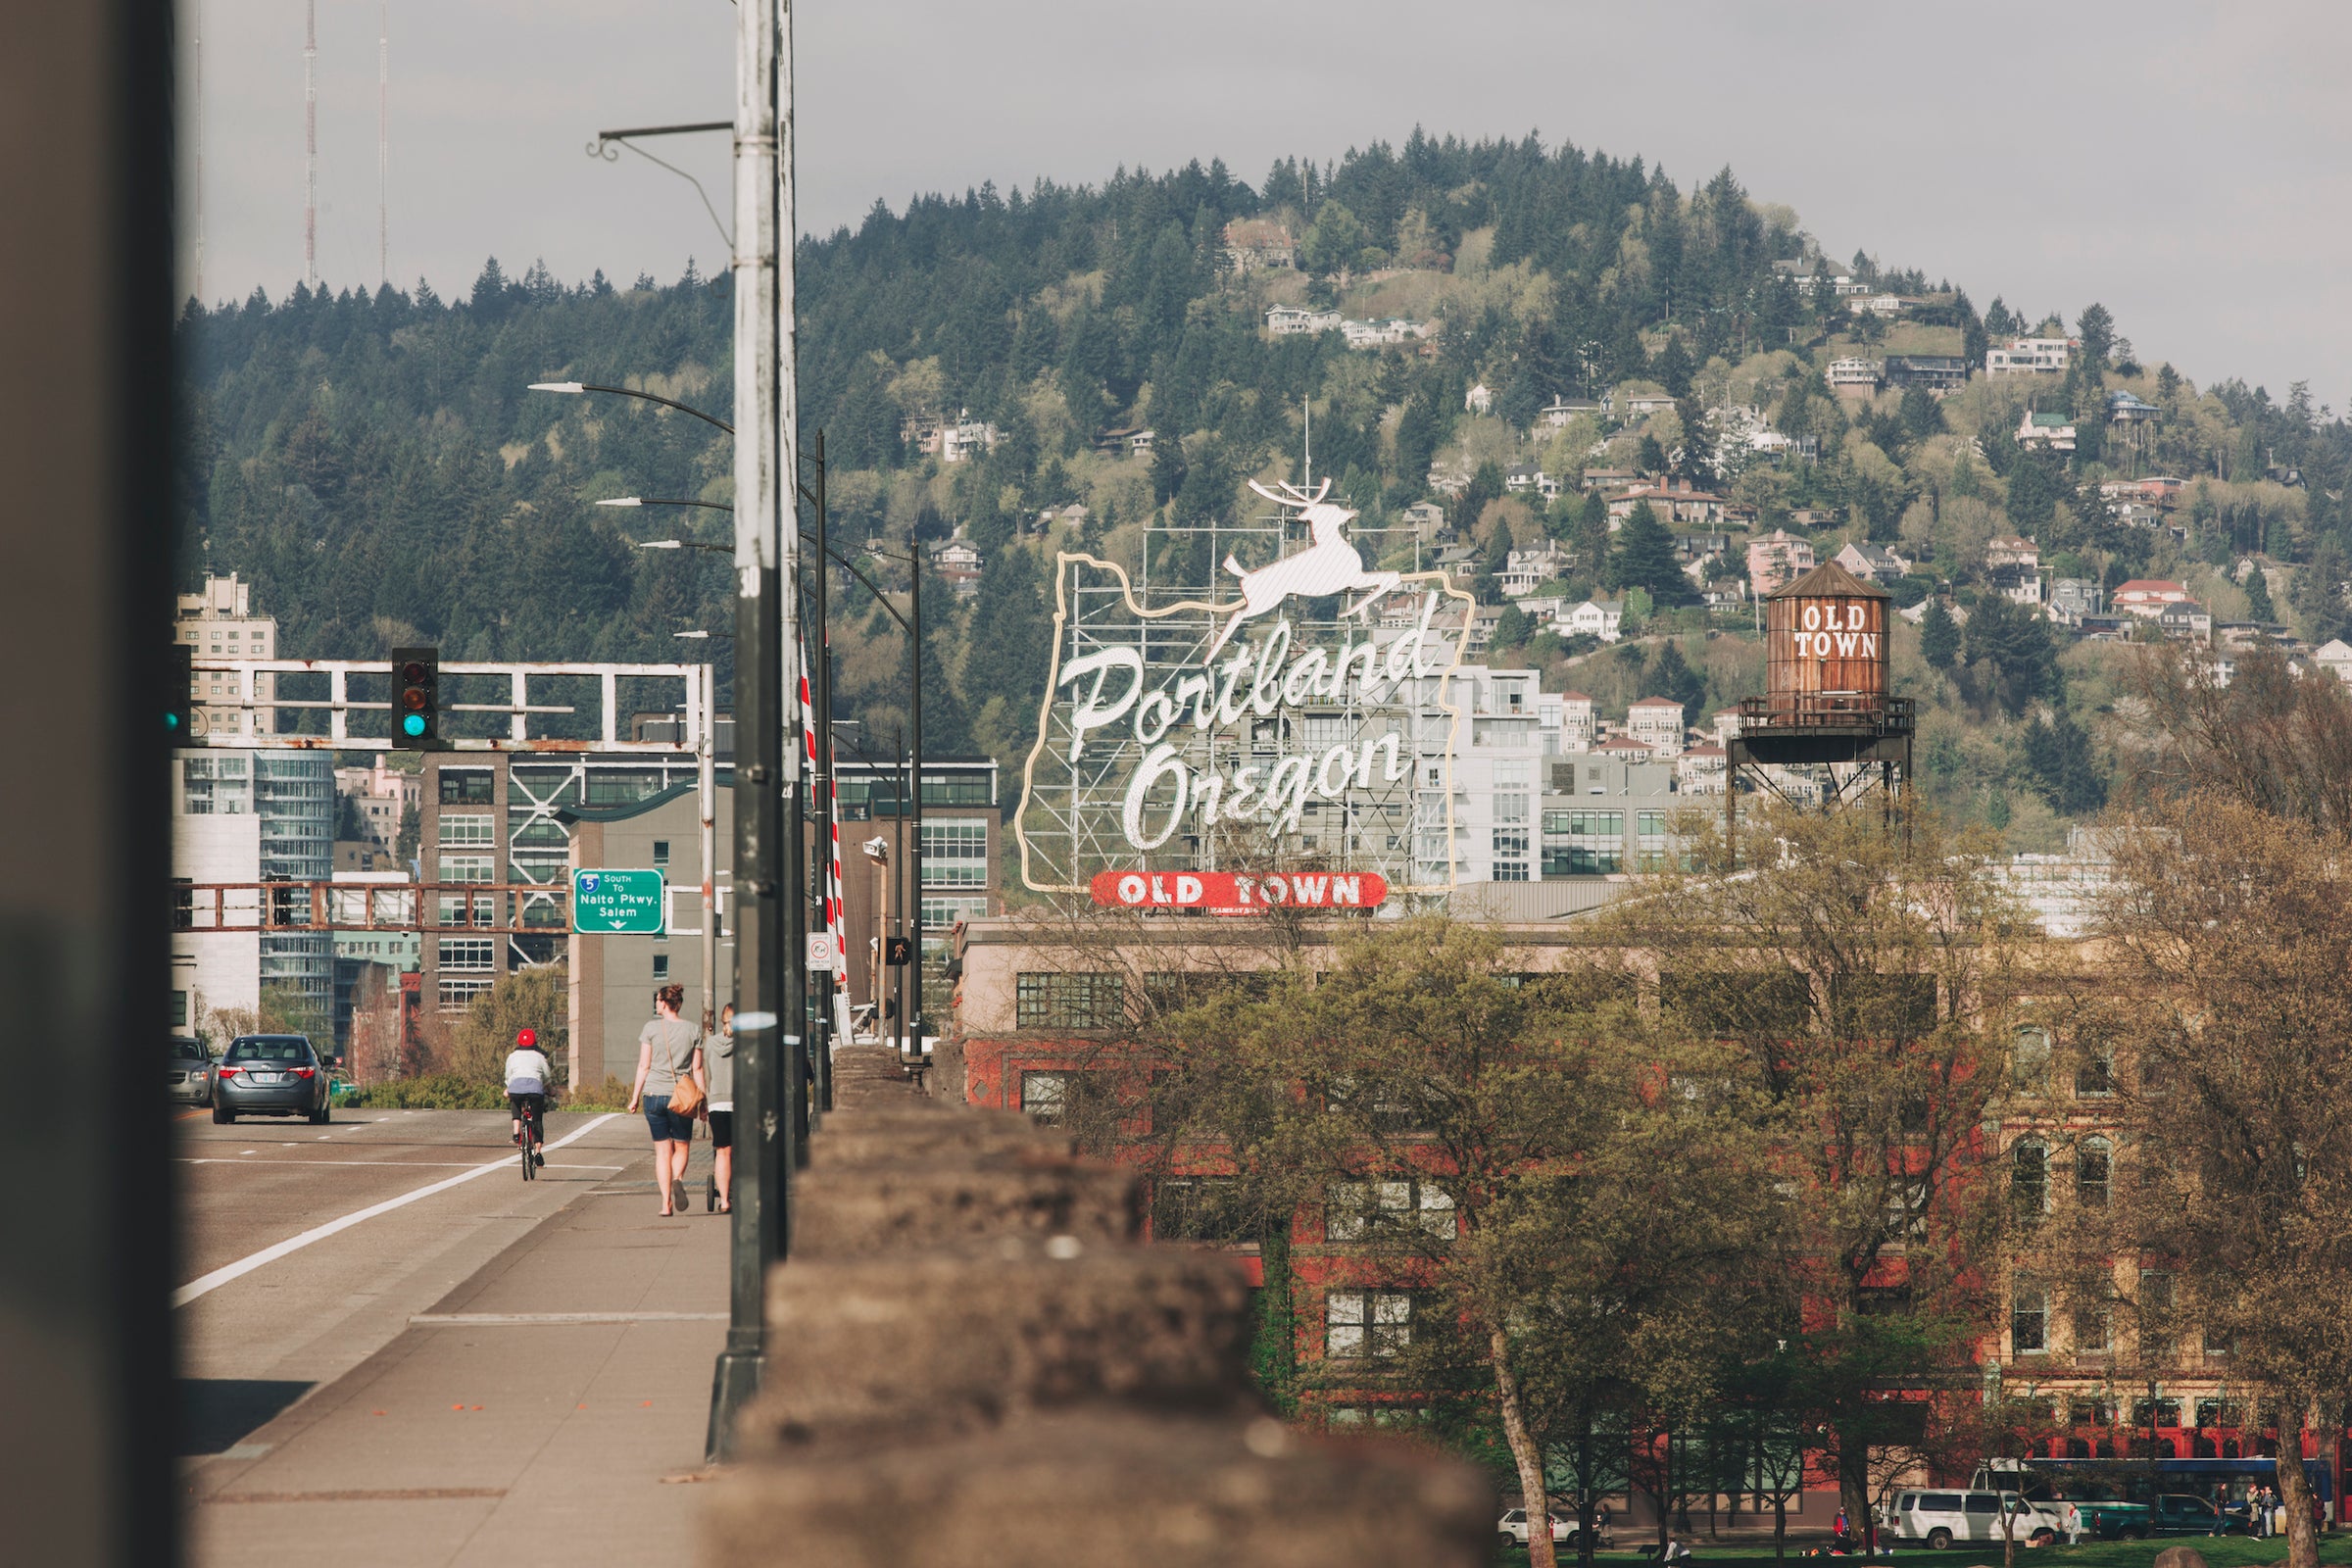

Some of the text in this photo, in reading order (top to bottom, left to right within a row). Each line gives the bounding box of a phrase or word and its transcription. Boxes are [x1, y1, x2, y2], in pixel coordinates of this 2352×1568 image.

[1804, 605, 1866, 630] OLD
[1793, 631, 1878, 658] TOWN
[1059, 589, 1442, 762] Portland
[1122, 732, 1414, 850] Oregon
[586, 874, 632, 890] 5 SOUTH
[1117, 875, 1360, 904] OLD TOWN
[580, 894, 658, 906] Naito Pkwy.
[599, 906, 637, 917] Salem
